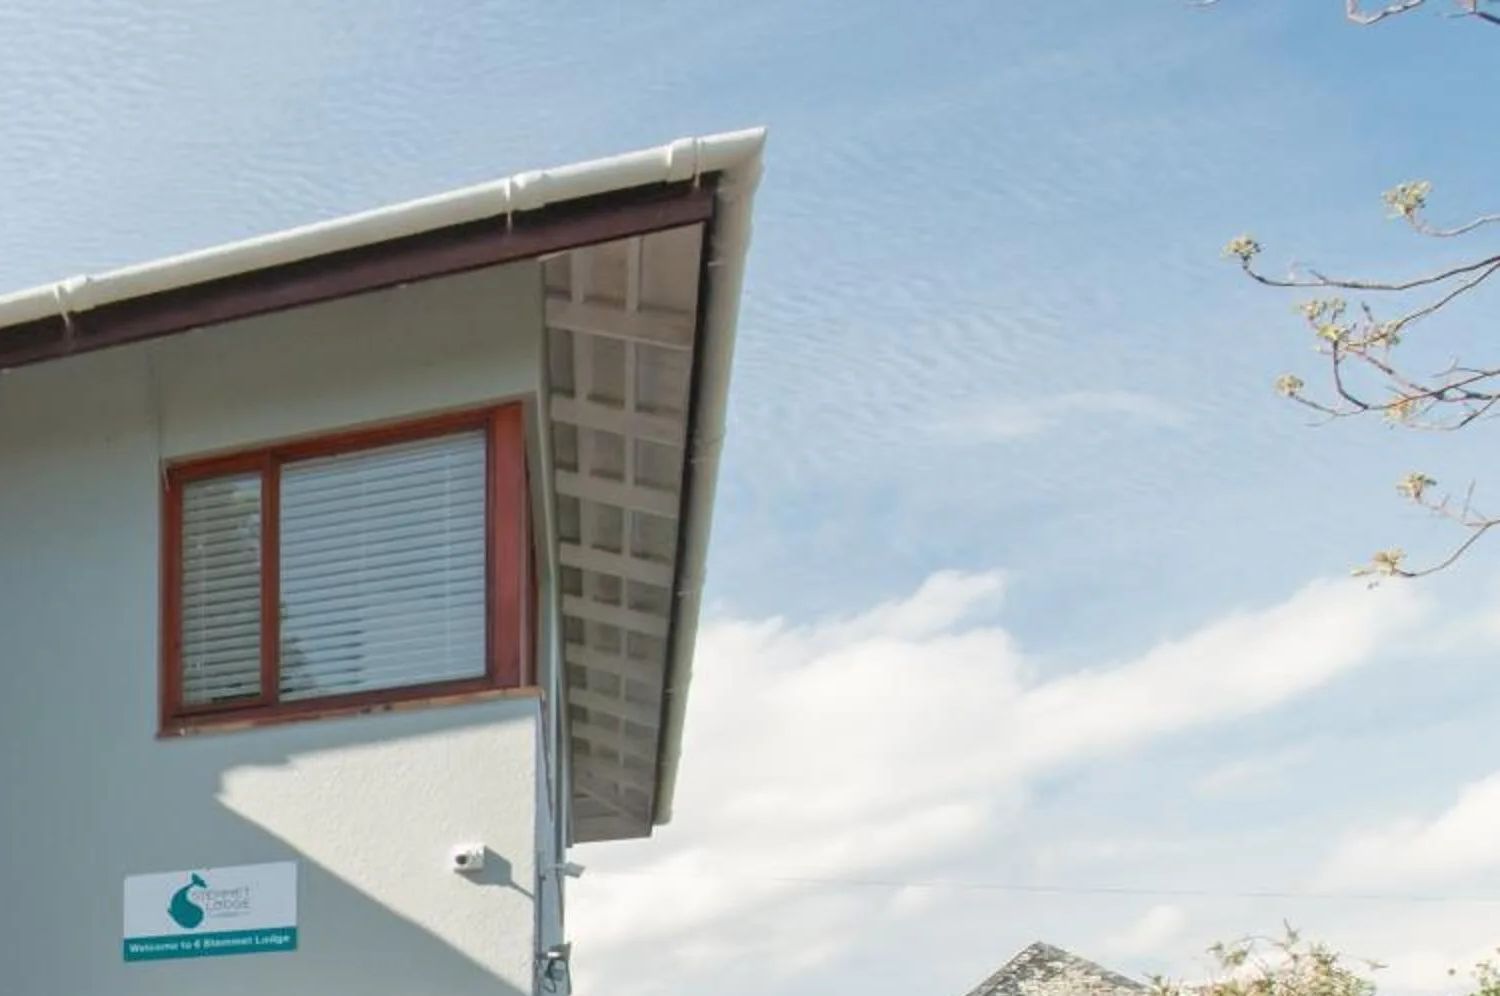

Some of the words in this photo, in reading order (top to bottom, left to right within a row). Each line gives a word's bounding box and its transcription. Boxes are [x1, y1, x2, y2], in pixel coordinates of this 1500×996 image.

[129, 942, 179, 953] Welcome
[180, 939, 193, 950] to
[255, 934, 291, 946] Lodge
